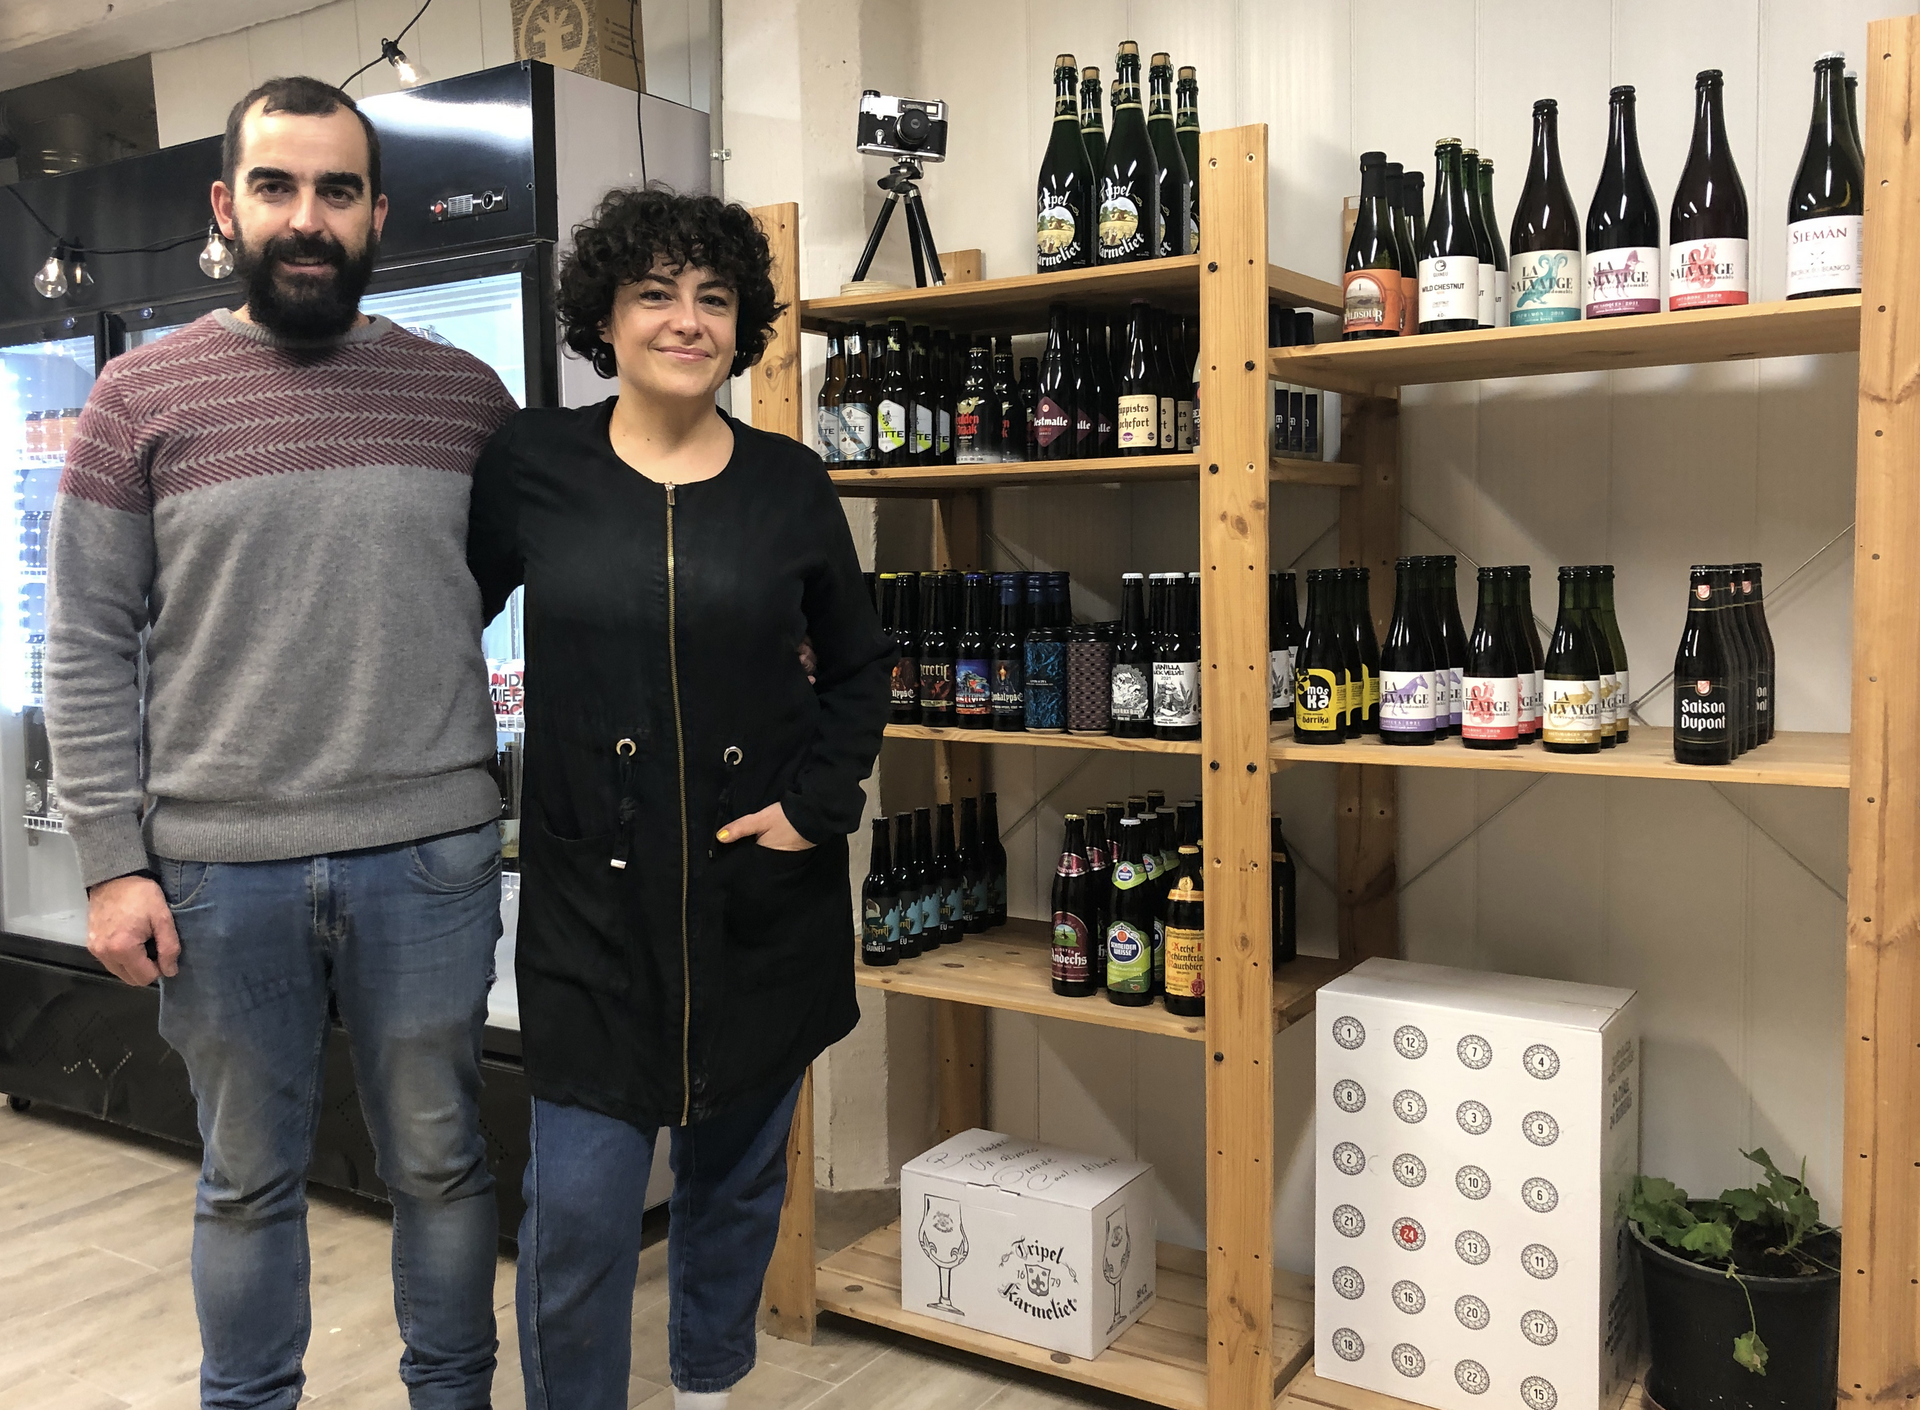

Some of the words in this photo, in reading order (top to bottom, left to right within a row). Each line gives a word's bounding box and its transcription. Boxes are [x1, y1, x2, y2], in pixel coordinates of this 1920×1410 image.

[1037, 241, 1081, 267] armeliet
[1681, 252, 1696, 264] LA
[1522, 266, 1538, 277] LA
[1598, 261, 1614, 271] LA
[1434, 283, 1465, 291] CHESTNUT
[1307, 686, 1329, 695] mos
[1385, 681, 1397, 691] LA
[1466, 688, 1477, 697] LA
[1381, 693, 1429, 704] ALVATGE
[1463, 701, 1510, 711] ALVATGE
[1681, 699, 1726, 714] Saison
[1681, 714, 1726, 732] Dupont
[1110, 942, 1137, 951] SCHNEIDER
[1347, 1029, 1351, 1038] 1
[1406, 1037, 1416, 1048] 12
[1472, 1047, 1477, 1058] 7
[1538, 1057, 1544, 1068] 4
[1347, 1092, 1352, 1101] 8
[1408, 1102, 1413, 1112] 5
[1471, 1113, 1477, 1123] 3
[1538, 1123, 1543, 1134] 9
[1347, 1154, 1352, 1164] 2
[969, 1160, 994, 1171] Un
[1405, 1166, 1414, 1176] 14
[1468, 1177, 1478, 1188] 10
[1537, 1190, 1542, 1200] 6
[1344, 1216, 1354, 1227] 21
[1404, 1229, 1414, 1240] 24
[1012, 1236, 1064, 1264] Tripel
[1467, 1243, 1478, 1254] 13
[1535, 1256, 1544, 1267] 11
[1017, 1270, 1026, 1280] 16
[1051, 1278, 1061, 1288] 79
[1343, 1278, 1353, 1288] 23
[998, 1283, 1077, 1320] Karmeliet
[1404, 1292, 1414, 1303] 16
[1466, 1307, 1478, 1318] 20
[1534, 1322, 1544, 1333] 17
[1343, 1340, 1353, 1350] 18
[1403, 1355, 1414, 1366] 19
[1467, 1371, 1477, 1382] 22
[1534, 1388, 1544, 1399] 15
